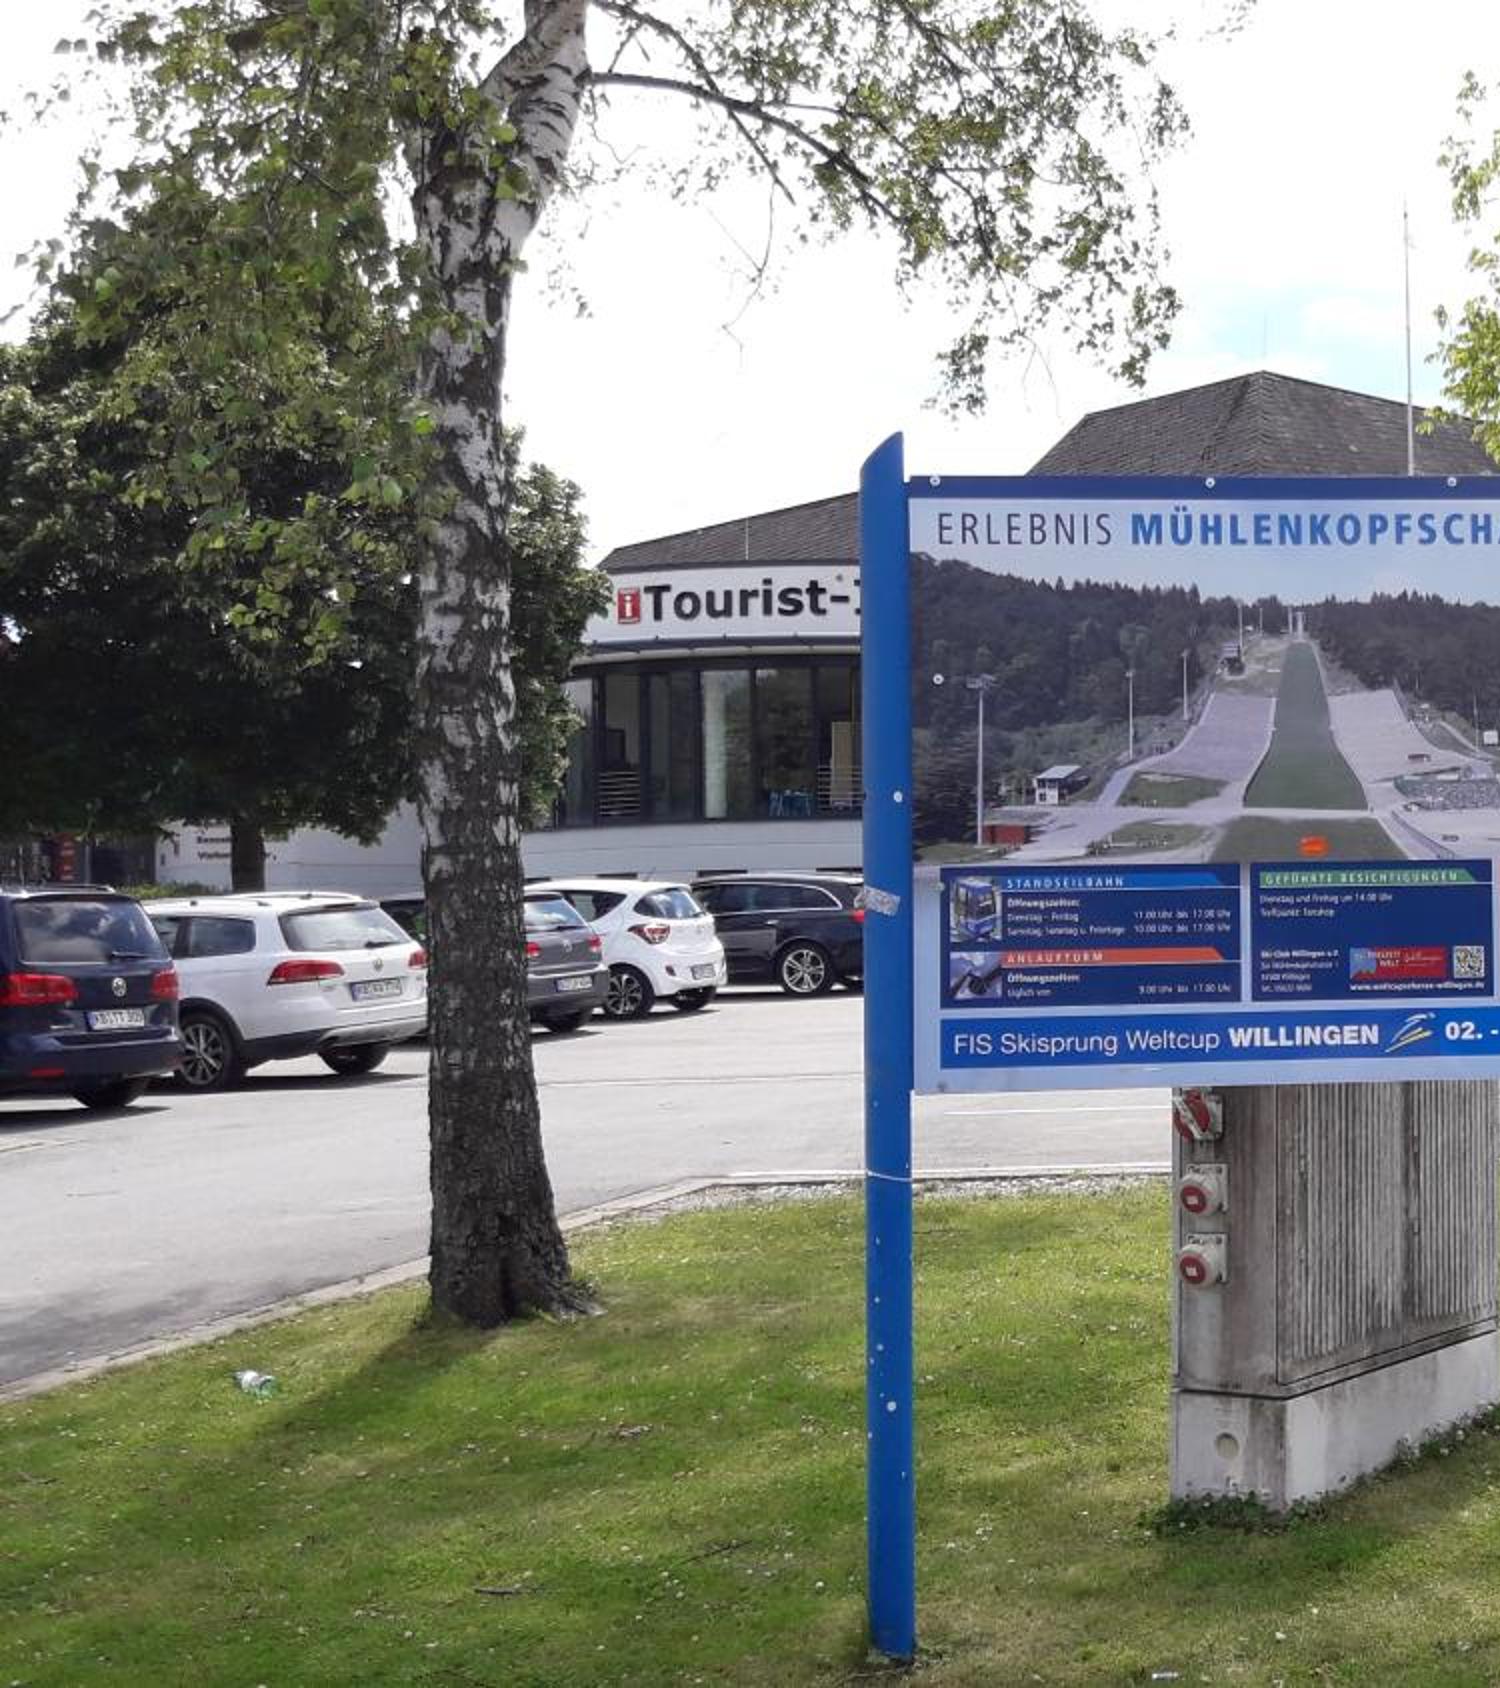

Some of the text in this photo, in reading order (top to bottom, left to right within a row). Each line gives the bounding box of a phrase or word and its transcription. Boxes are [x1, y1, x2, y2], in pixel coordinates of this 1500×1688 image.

[938, 512, 1111, 545] ERLEBNIS
[1007, 877, 1124, 889] STANDSEILBAHN
[1265, 871, 1458, 886] GEFÜHRTE BESICHTIGUNGEN
[1007, 952, 1103, 964] ANLAUFTURM
[1444, 1020, 1483, 1041] 02.
[954, 1023, 1379, 1058] FIS Skisprung Weltcup WILLINGEN
